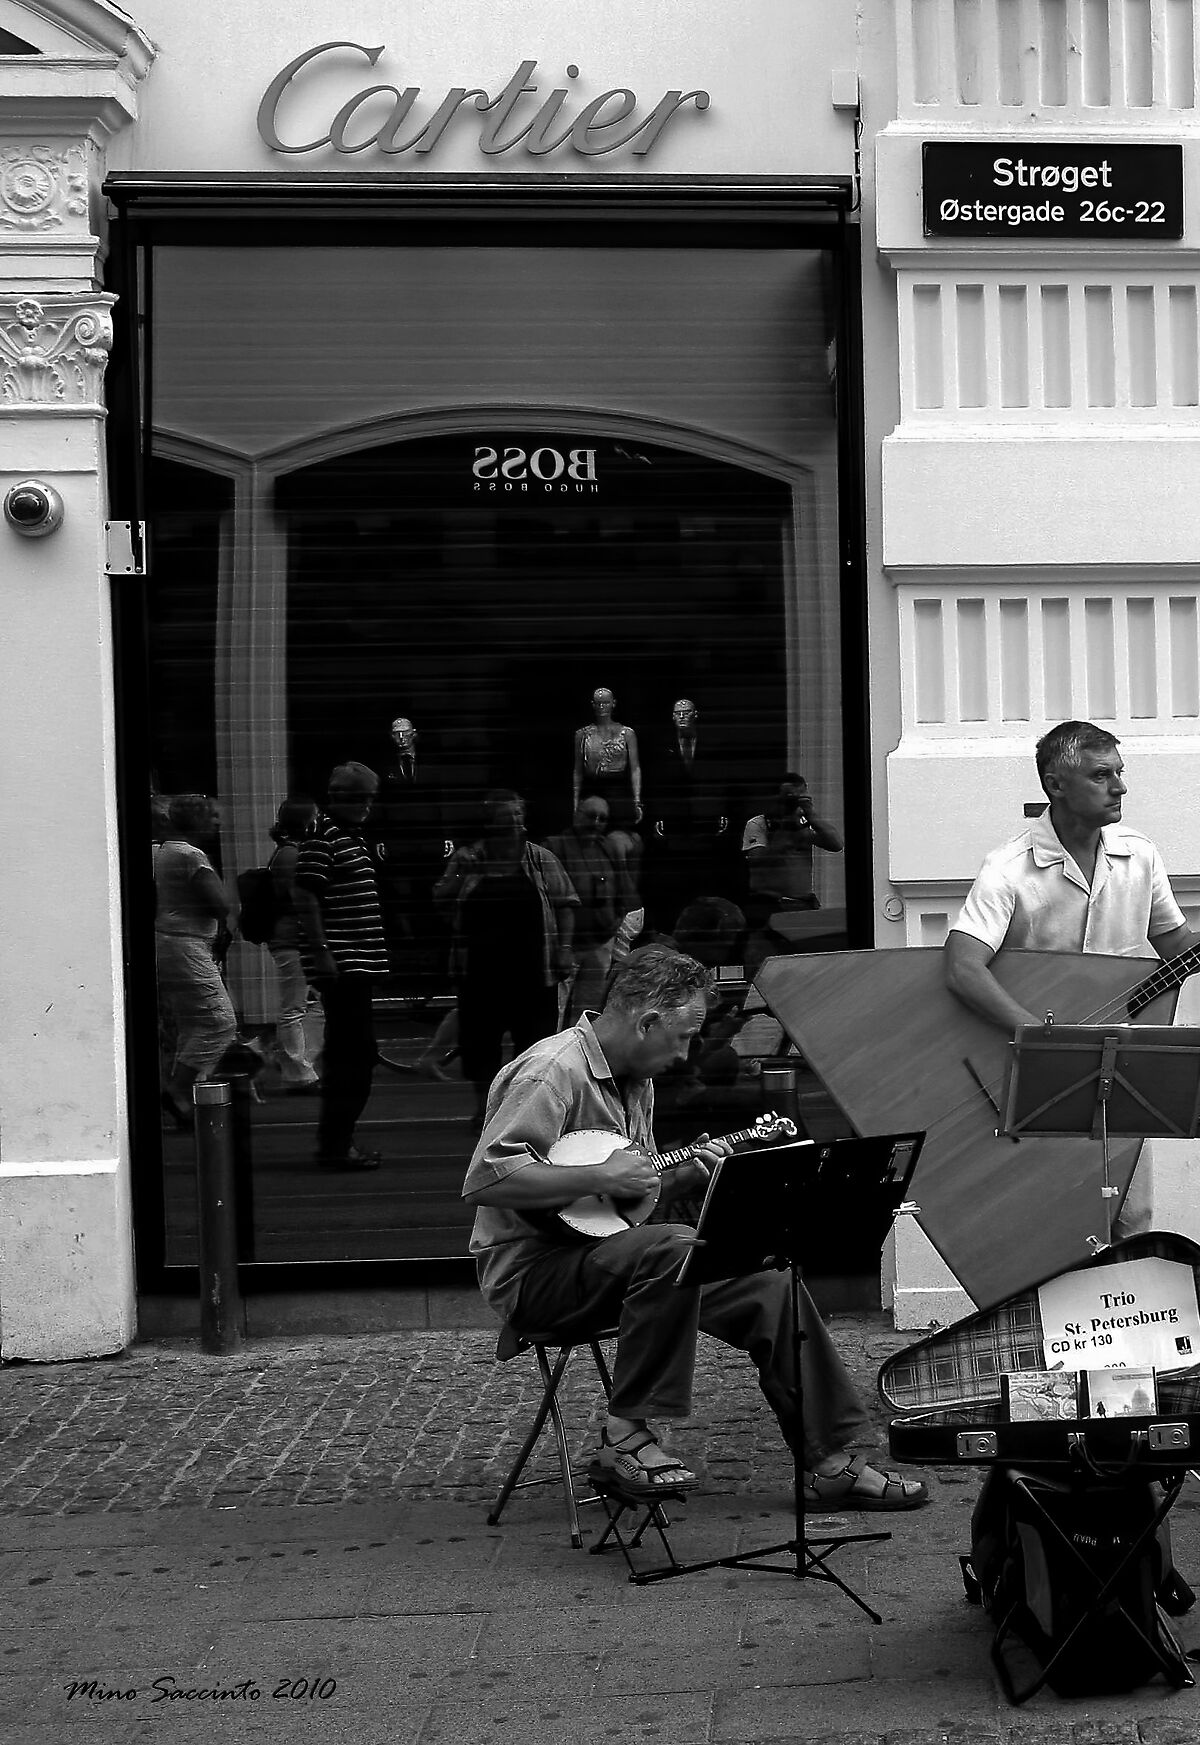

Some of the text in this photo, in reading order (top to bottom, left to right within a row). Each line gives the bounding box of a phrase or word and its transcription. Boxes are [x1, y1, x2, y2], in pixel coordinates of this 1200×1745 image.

[257, 41, 710, 156] Cartier
[993, 158, 1113, 192] Strøget
[940, 199, 1166, 225] Østergade 26c-22
[1100, 1291, 1136, 1309] Trio
[1064, 1307, 1179, 1337] St. Petersburg
[1051, 1333, 1113, 1353] CD kr 130
